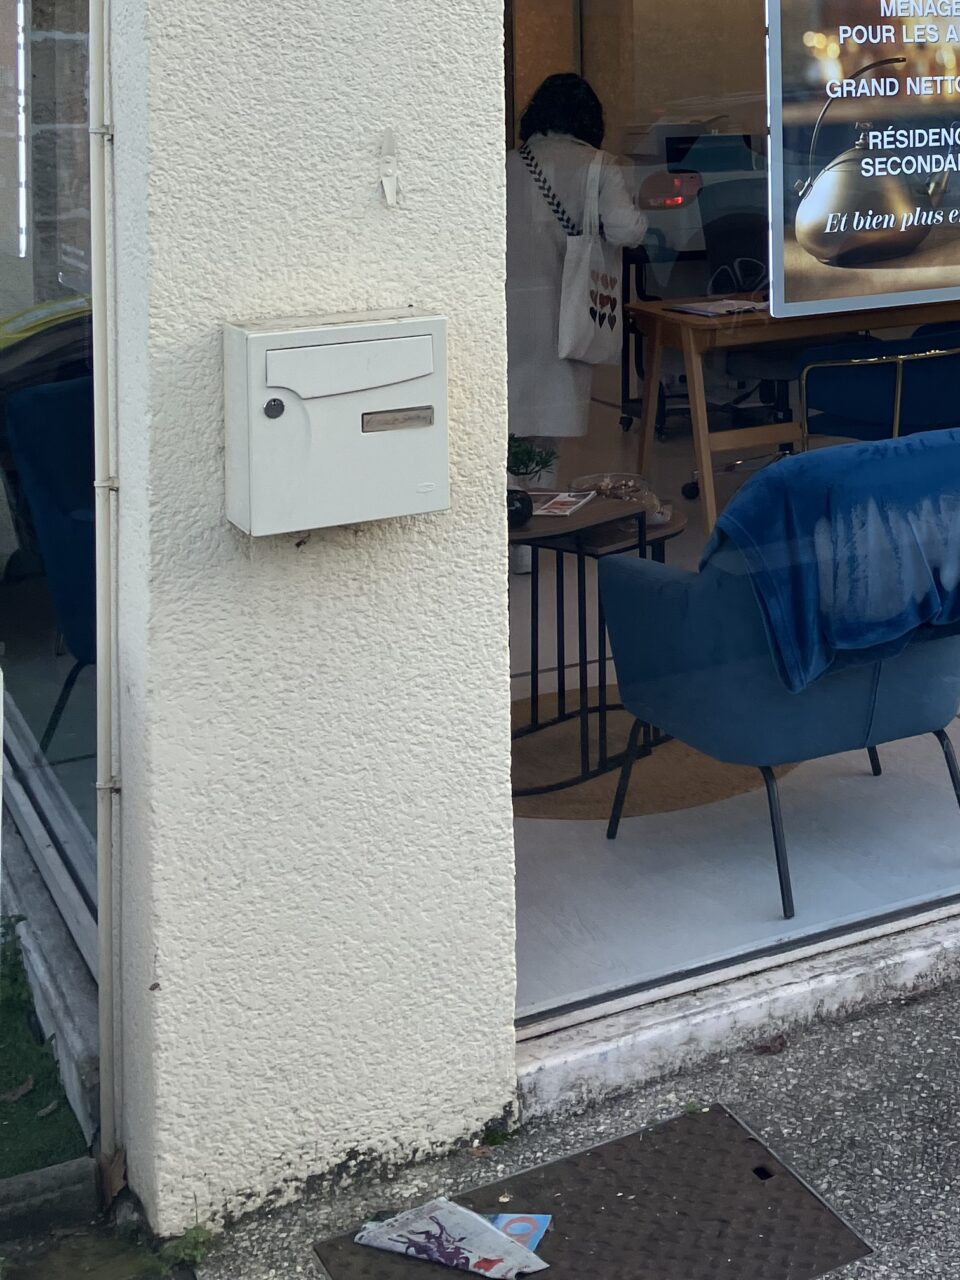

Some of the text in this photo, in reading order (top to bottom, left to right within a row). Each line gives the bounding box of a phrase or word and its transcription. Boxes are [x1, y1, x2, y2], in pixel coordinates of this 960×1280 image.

[839, 26, 895, 45] POUR
[902, 24, 939, 43] LES
[825, 79, 899, 98] GRAND
[824, 211, 848, 234] Et
[853, 207, 896, 231] bien
[901, 203, 944, 233] plus
